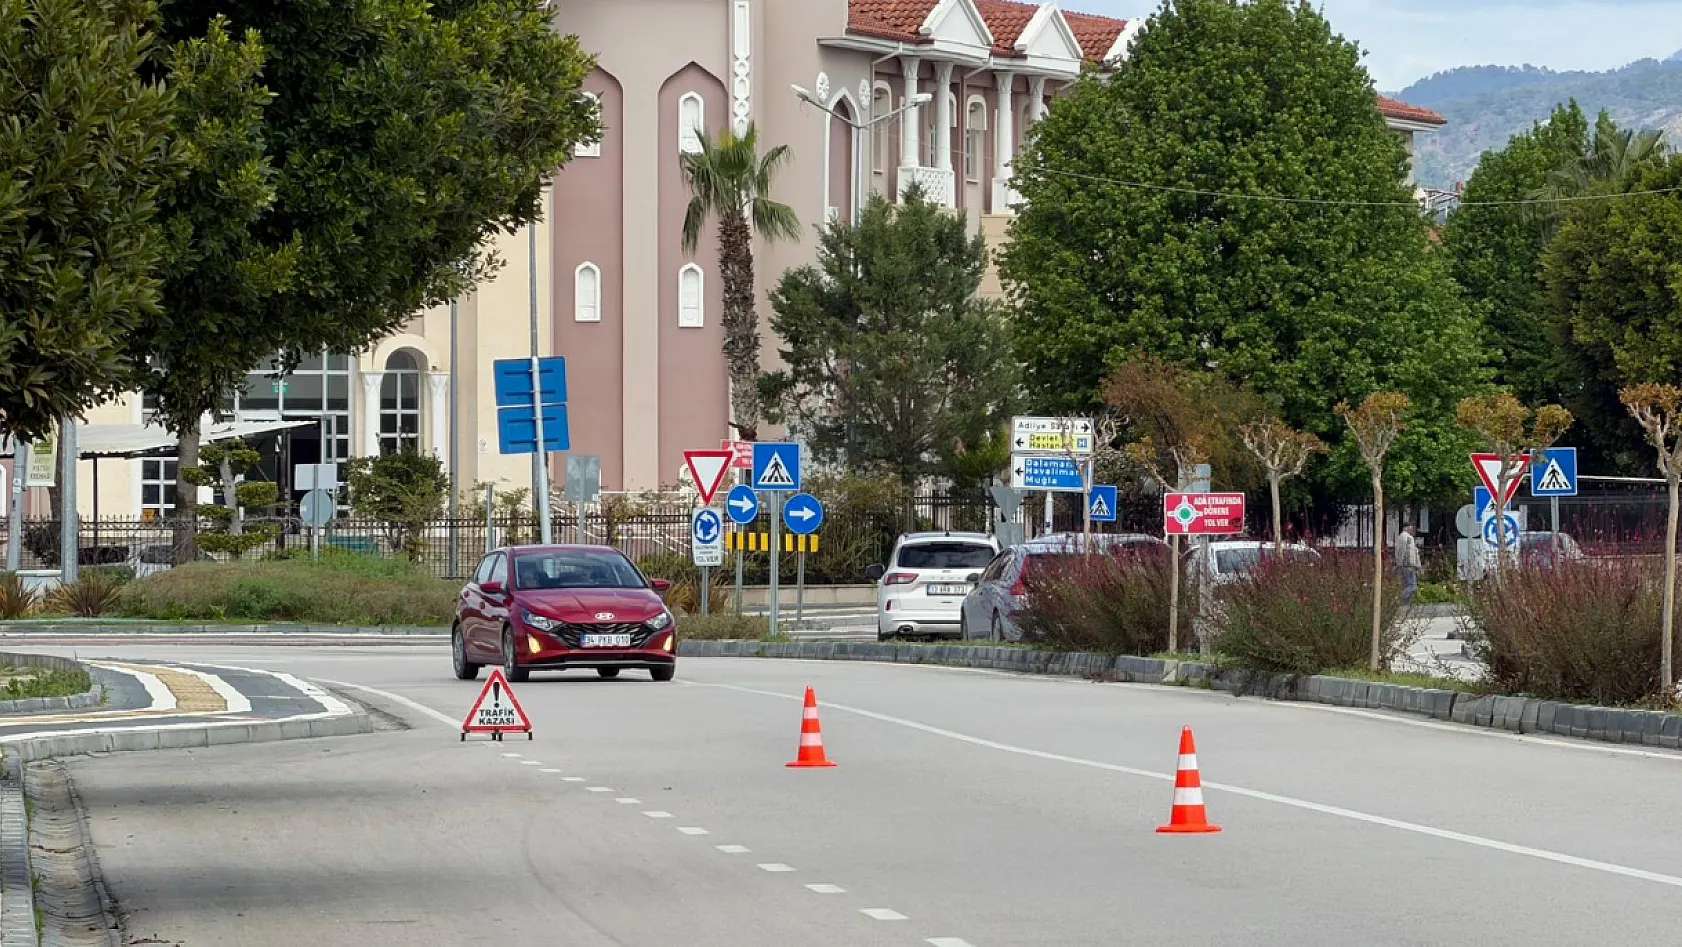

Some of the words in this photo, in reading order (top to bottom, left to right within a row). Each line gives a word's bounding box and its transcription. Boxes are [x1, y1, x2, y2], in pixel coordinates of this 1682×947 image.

[1017, 421, 1047, 431] Adliye
[1025, 459, 1074, 467] Dalaman
[1025, 476, 1058, 486] Muğla
[1194, 496, 1208, 505] ADA
[478, 708, 515, 717] TRAFİK
[479, 717, 515, 725] KAZASI
